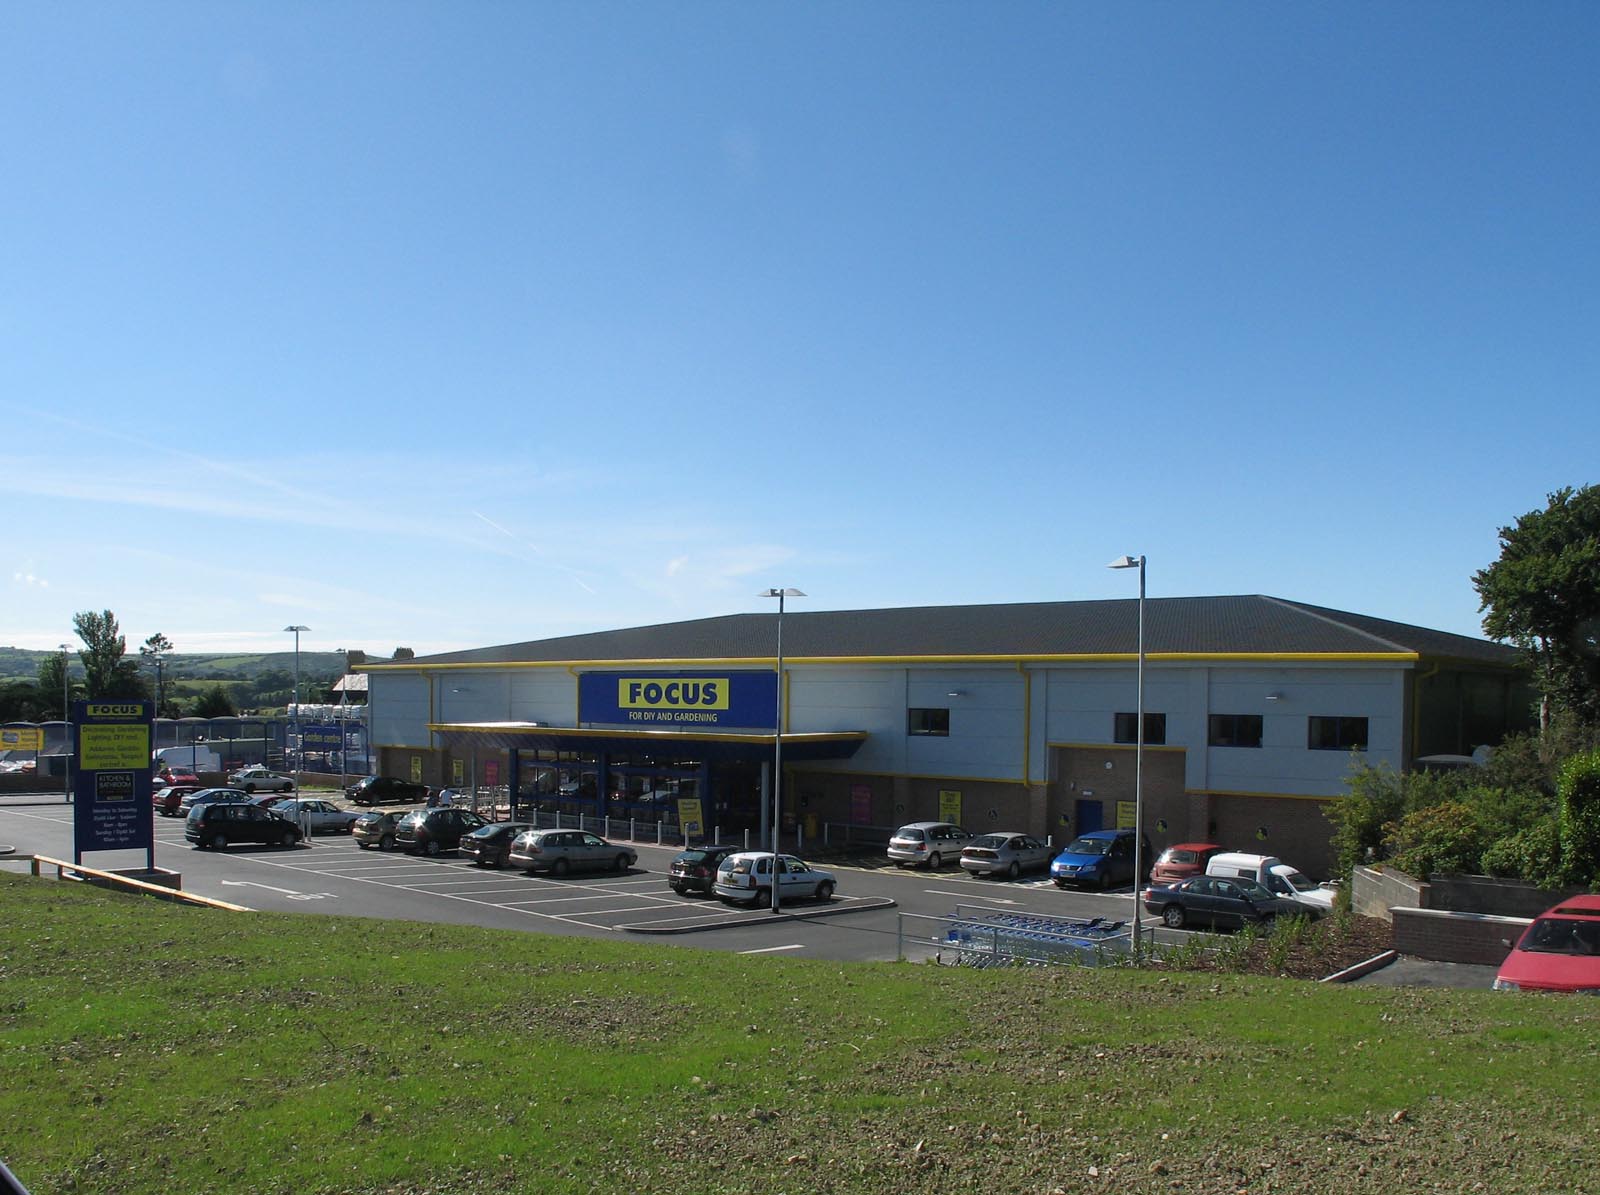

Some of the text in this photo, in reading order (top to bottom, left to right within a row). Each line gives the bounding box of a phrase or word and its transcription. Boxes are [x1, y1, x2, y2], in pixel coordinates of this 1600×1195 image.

[629, 682, 718, 705] FOCUS
[92, 705, 138, 714] FOCUS
[629, 711, 718, 722] FOR DIY AND GARDENING
